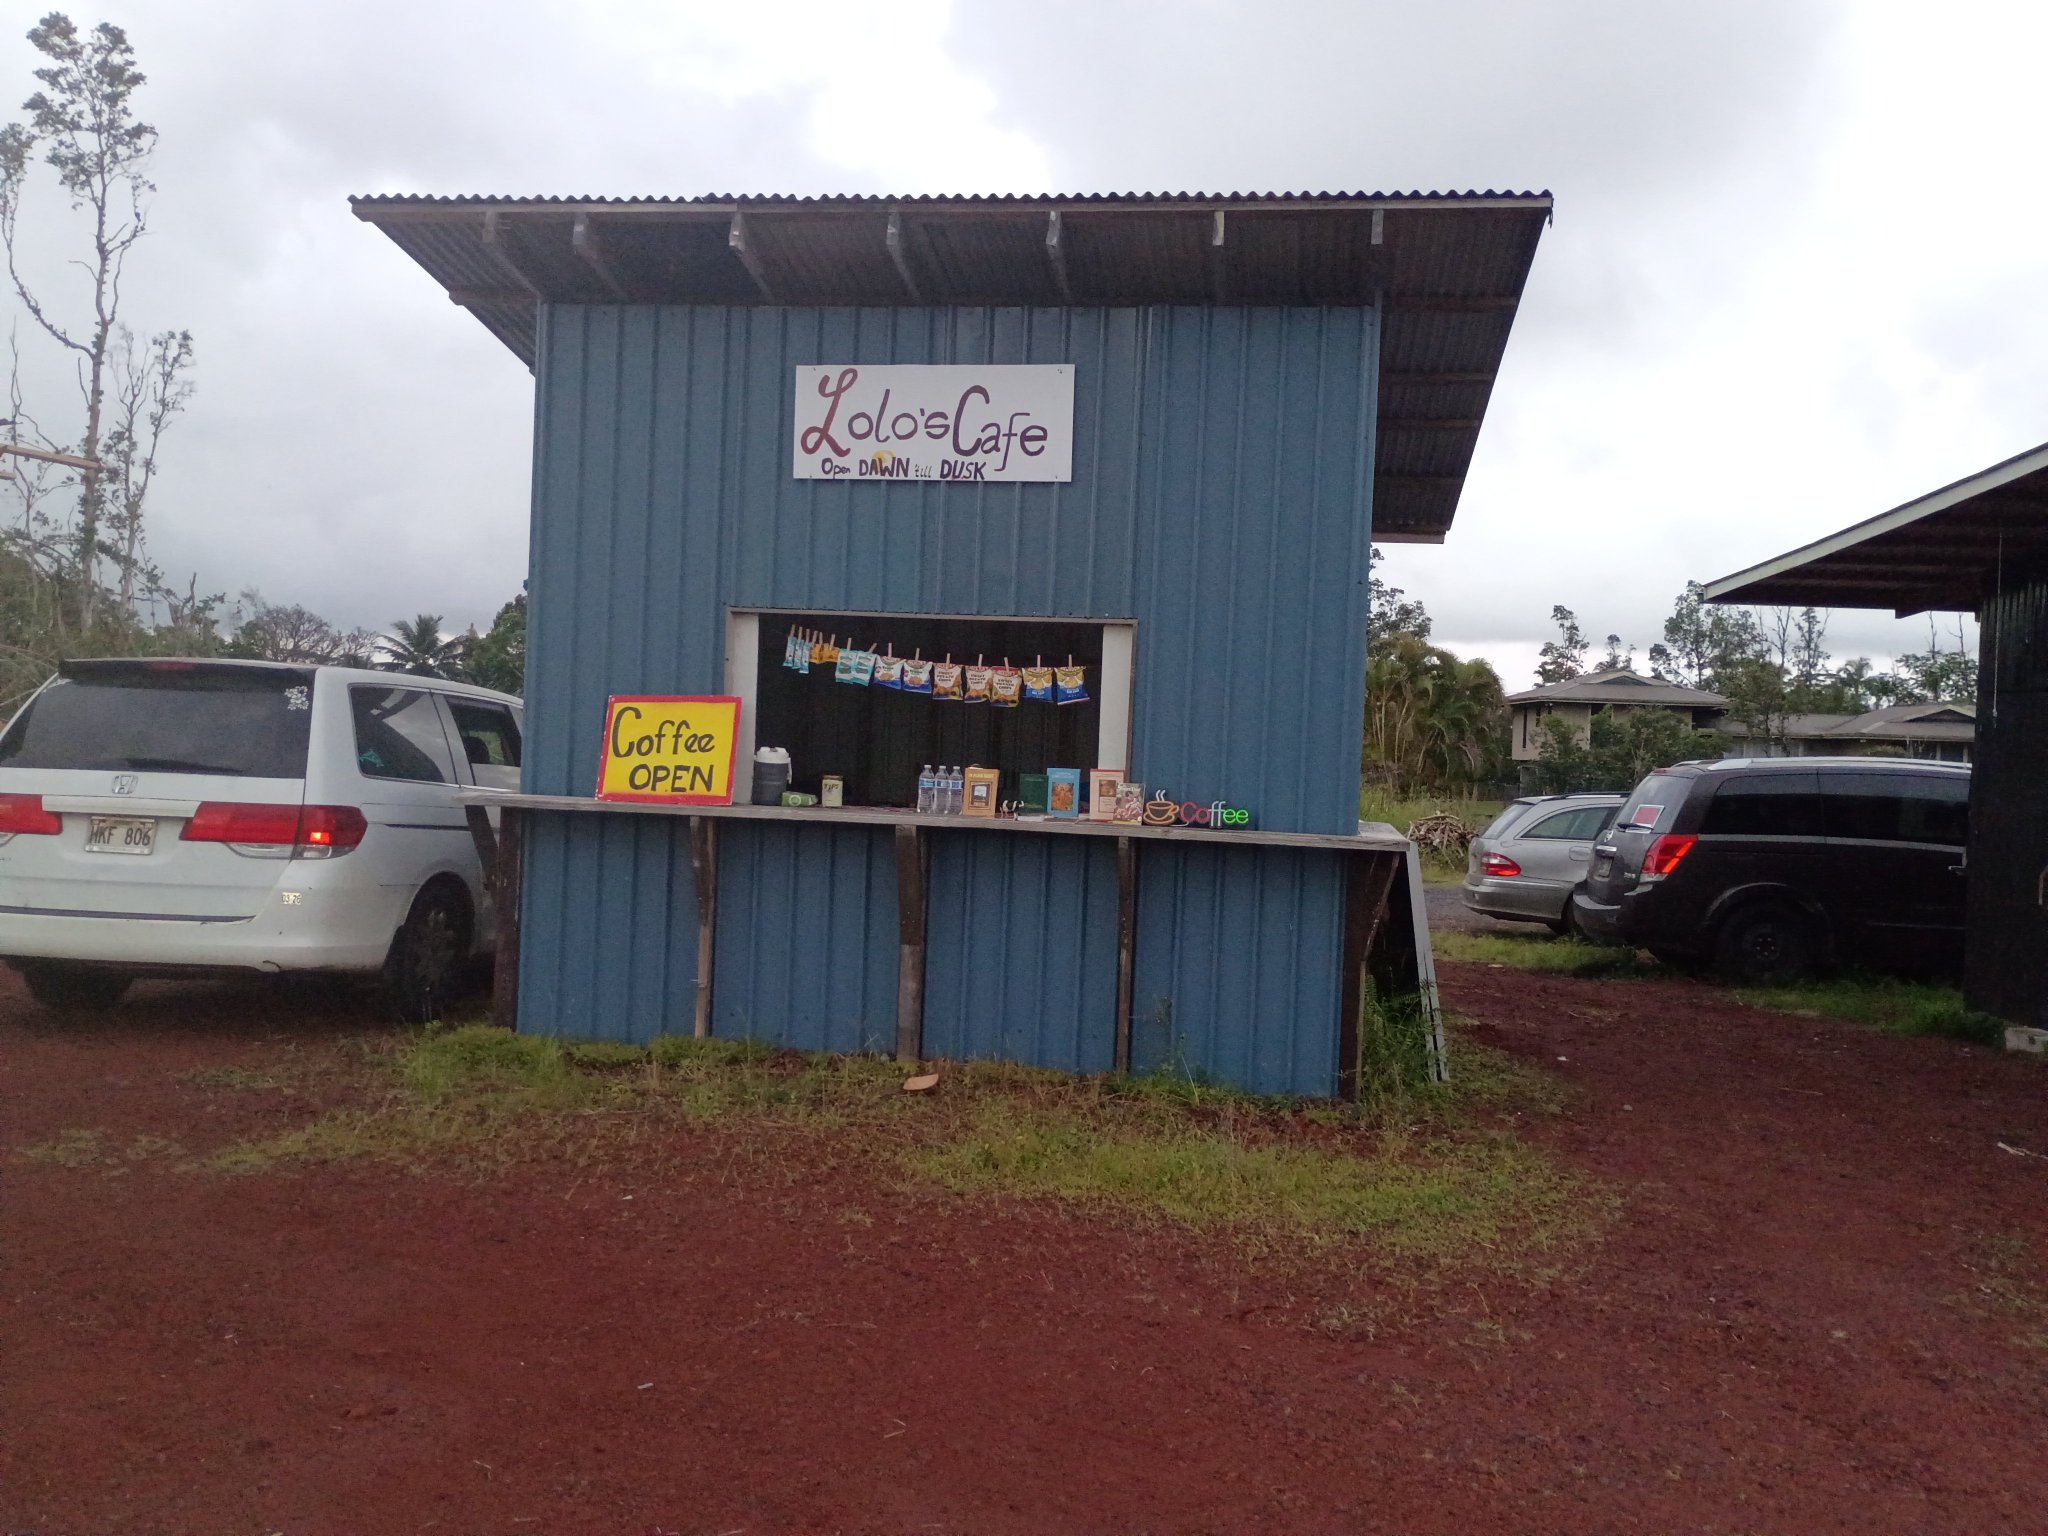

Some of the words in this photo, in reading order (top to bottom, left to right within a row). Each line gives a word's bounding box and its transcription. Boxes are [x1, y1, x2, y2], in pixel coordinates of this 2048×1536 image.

[800, 368, 950, 457] Lolo's
[952, 385, 1048, 472] Cafe
[821, 457, 850, 479] Open
[859, 457, 910, 477] DAWN
[940, 459, 987, 480] DUSK
[612, 706, 715, 758] Coffee
[629, 763, 714, 792] OPEN
[1180, 801, 1249, 827] Coffee
[89, 826, 117, 845] HKF
[124, 827, 152, 846] 806
